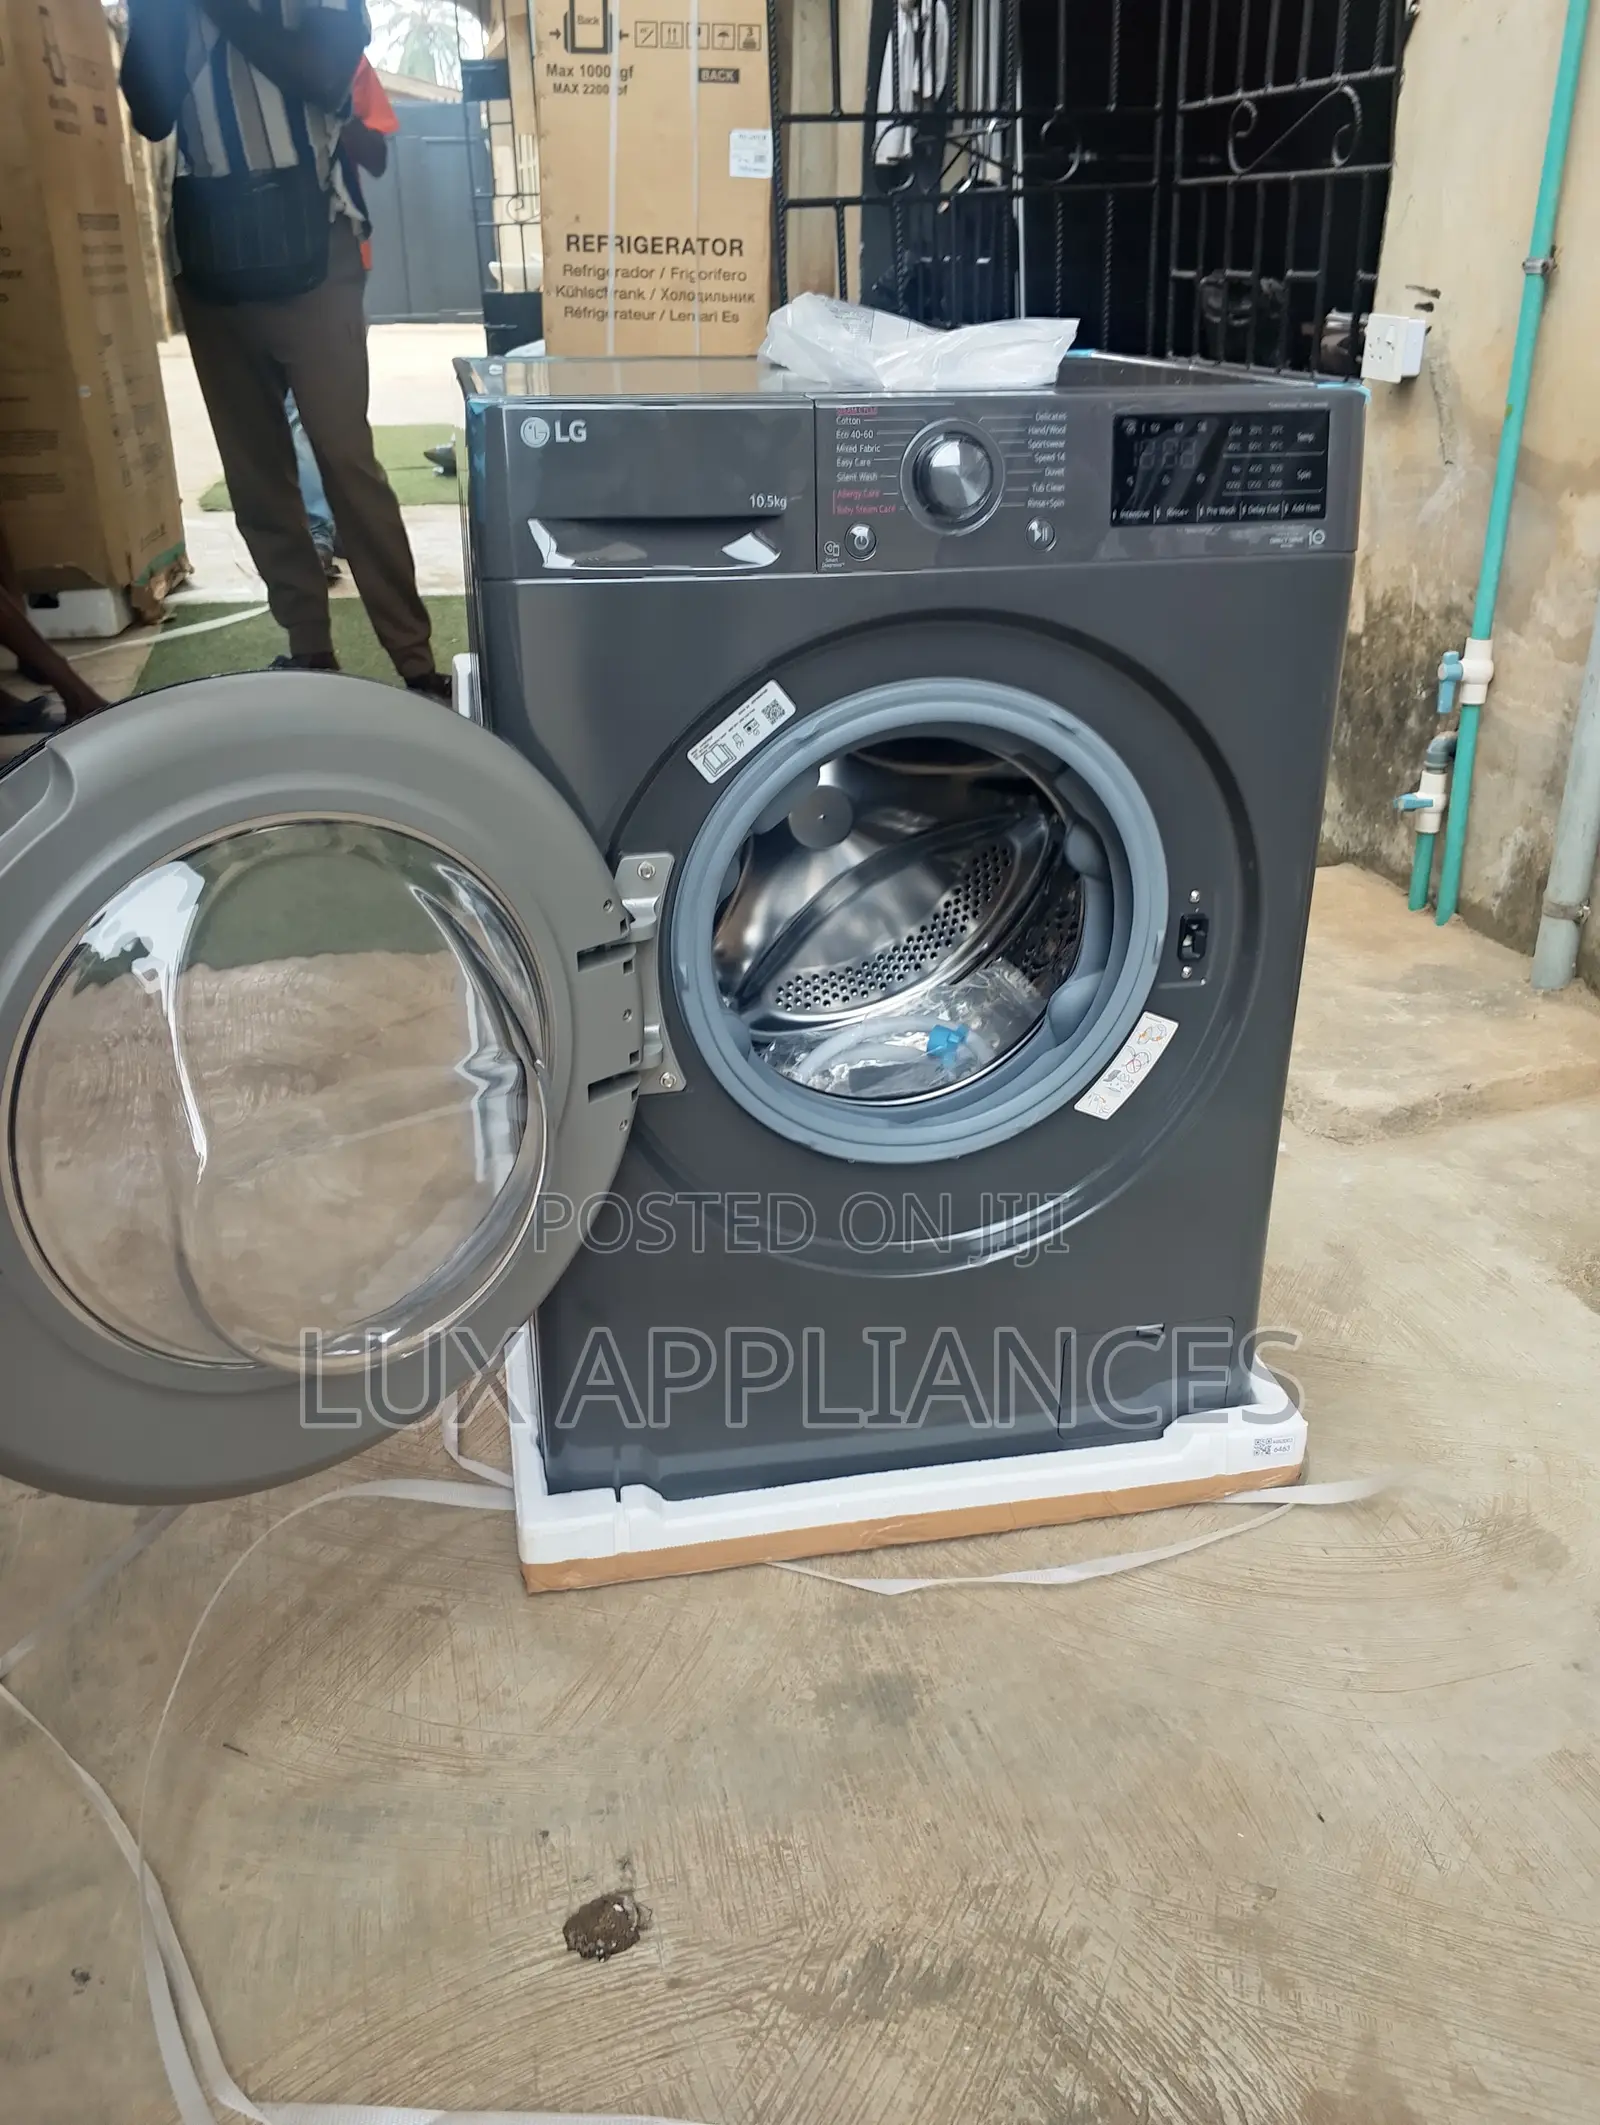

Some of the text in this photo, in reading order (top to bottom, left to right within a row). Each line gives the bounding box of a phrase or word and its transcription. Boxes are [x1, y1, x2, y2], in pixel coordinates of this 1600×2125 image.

[577, 15, 600, 25] Back
[546, 64, 634, 82] Max 1000gf
[701, 70, 735, 82] BACK
[553, 83, 579, 95] MAX
[566, 233, 744, 257] REFRIGERATOR
[722, 311, 740, 323] Es
[836, 416, 861, 425] Cotton
[1035, 412, 1067, 421] Delicates
[555, 420, 587, 442] LG
[836, 430, 874, 439] Eco 40-60
[1028, 424, 1067, 435] Hand/Wool
[836, 444, 881, 453] Mixed Fabric
[1028, 439, 1066, 450] Sportswear
[836, 458, 871, 468] Easy Care
[1034, 452, 1066, 463] Speed 14
[837, 471, 878, 482] Silent Wash
[1044, 466, 1065, 477] Duvet
[1032, 482, 1065, 492] Tub Clean
[837, 489, 880, 500] Allergy Care
[1027, 498, 1065, 509] Rinse+Spin
[855, 505, 878, 514] Steam
[879, 505, 897, 513] Care
